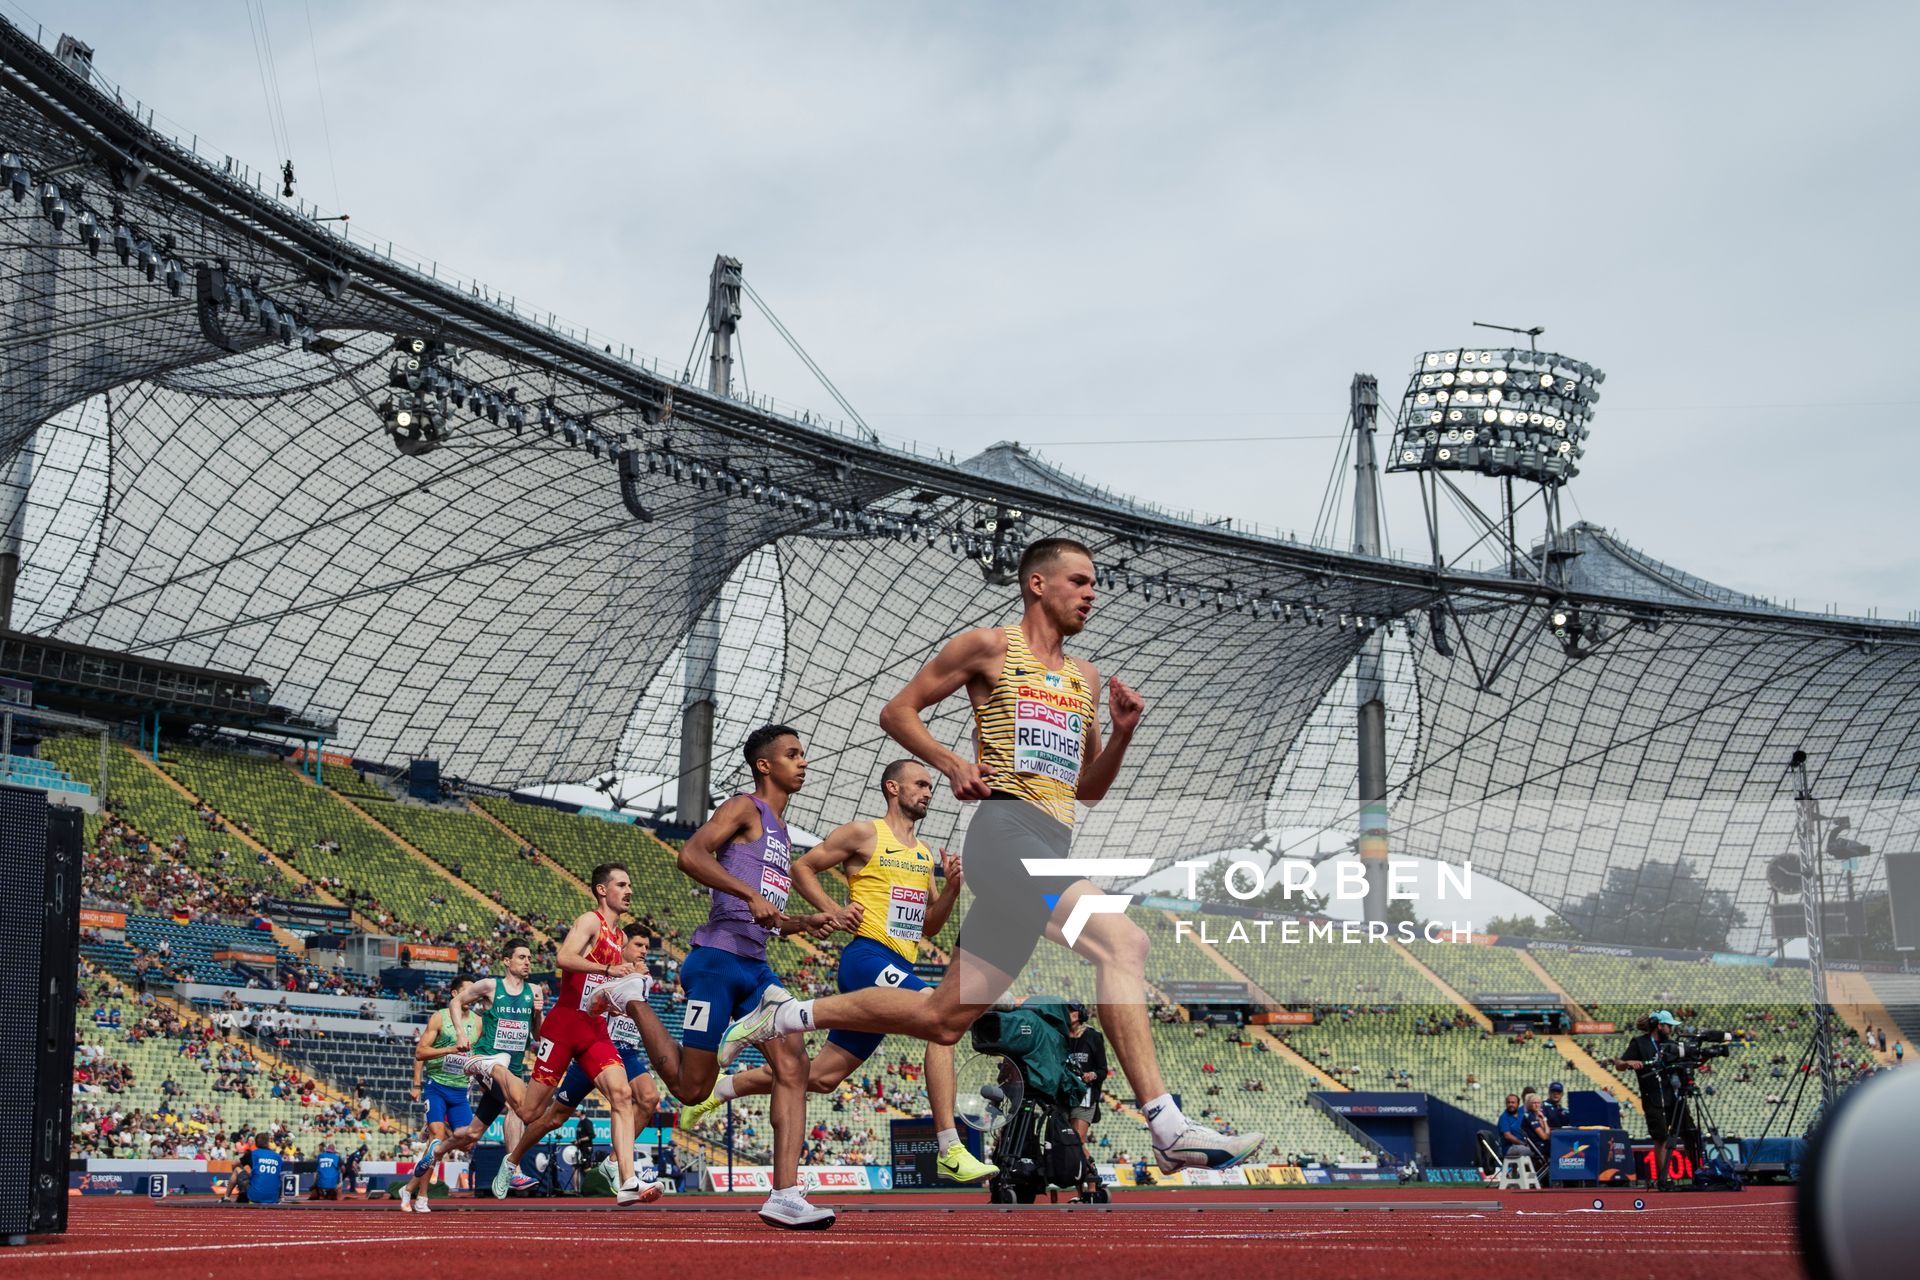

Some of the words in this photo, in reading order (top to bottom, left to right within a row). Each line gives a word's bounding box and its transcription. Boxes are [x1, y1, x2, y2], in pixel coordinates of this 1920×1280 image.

[1018, 686, 1084, 709] GERMANY
[1020, 703, 1065, 729] SPAR
[1018, 727, 1080, 760] REUTHER
[1020, 759, 1058, 775] MUNICH
[1059, 768, 1076, 784] 2022
[880, 856, 900, 868] Bosnia
[763, 869, 791, 890] SPAR
[892, 888, 925, 903] SPAR
[889, 927, 915, 940] MUNICH
[885, 970, 900, 985] 6
[496, 1006, 532, 1015] IRELAND
[690, 1005, 704, 1026] 7
[499, 1020, 521, 1029] SPAR
[496, 1030, 528, 1041] ENGLISH
[538, 1042, 548, 1057] 5
[258, 1157, 279, 1166] PHOTO
[259, 1165, 277, 1174] 010
[92, 1174, 122, 1182] EUROPEAN
[721, 1174, 756, 1185] SPAR
[826, 1173, 856, 1185] SPAR
[153, 1180, 162, 1192] 5
[286, 1180, 294, 1191] 4
